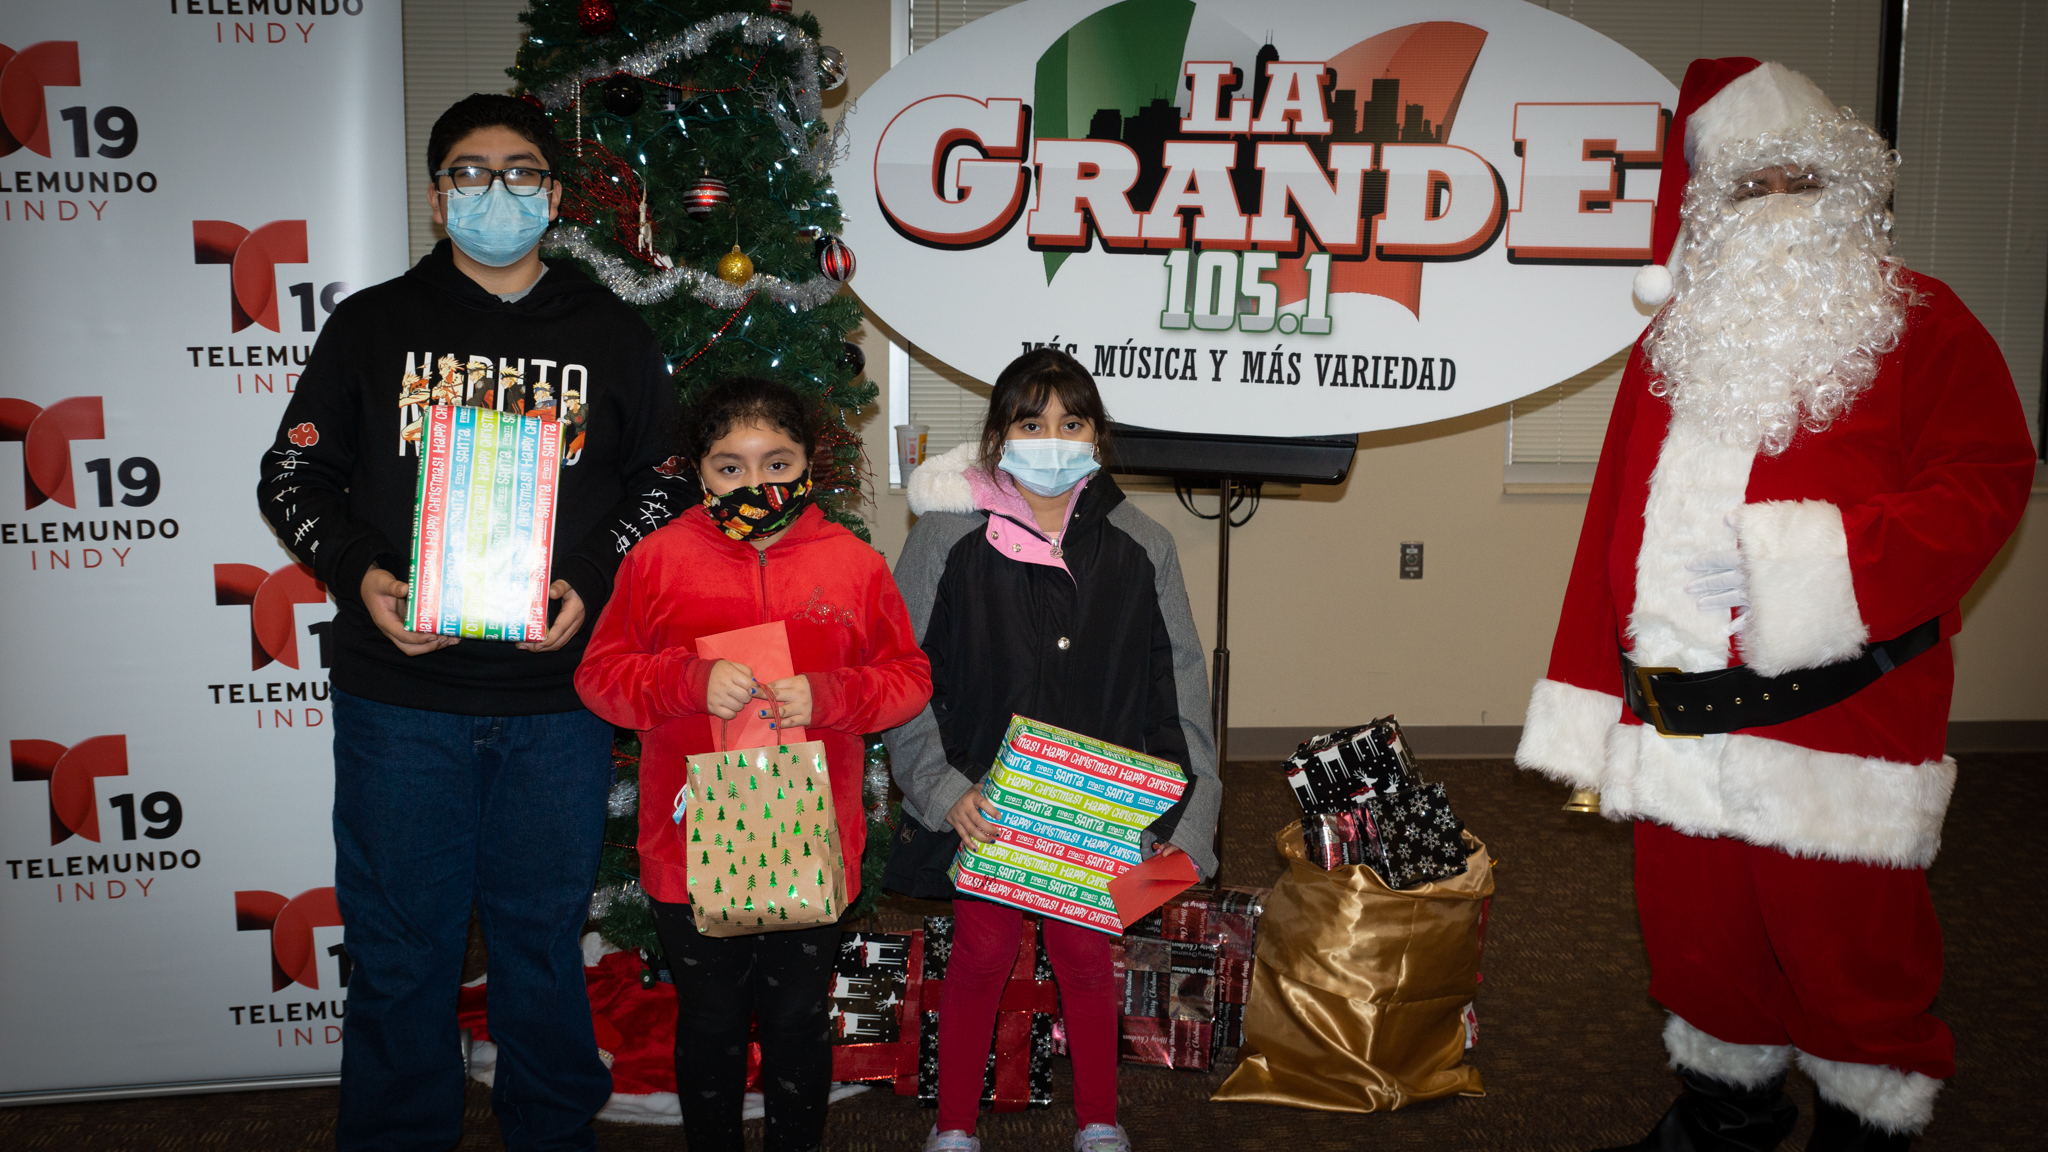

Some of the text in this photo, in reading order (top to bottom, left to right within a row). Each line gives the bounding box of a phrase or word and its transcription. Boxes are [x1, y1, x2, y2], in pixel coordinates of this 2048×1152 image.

[217, 22, 314, 43] INDY
[1180, 60, 1334, 136] LA
[60, 106, 139, 159] 19
[0, 171, 157, 193] LEMUNDO
[873, 93, 1668, 264] GRANDE
[6, 200, 108, 221] INDY
[1160, 247, 1332, 335] 105.1
[186, 345, 312, 368] TELEMU
[1092, 338, 1198, 381] MÚSICA
[1209, 349, 1228, 382] Y
[1240, 343, 1301, 386] MÁS
[1315, 352, 1457, 391] VARIEDAD
[237, 373, 300, 394] IND
[85, 456, 161, 508] 19
[1, 519, 179, 545] ELEMUNDO
[31, 547, 131, 571] INDY
[308, 621, 332, 669] 1
[208, 681, 329, 704] TELEMU
[257, 708, 324, 729] IND
[108, 791, 183, 841] 19
[6, 849, 201, 879] TELEMUNDO
[57, 878, 154, 903] INDY
[229, 1000, 347, 1026] TELEMU
[278, 1025, 343, 1048] IND
